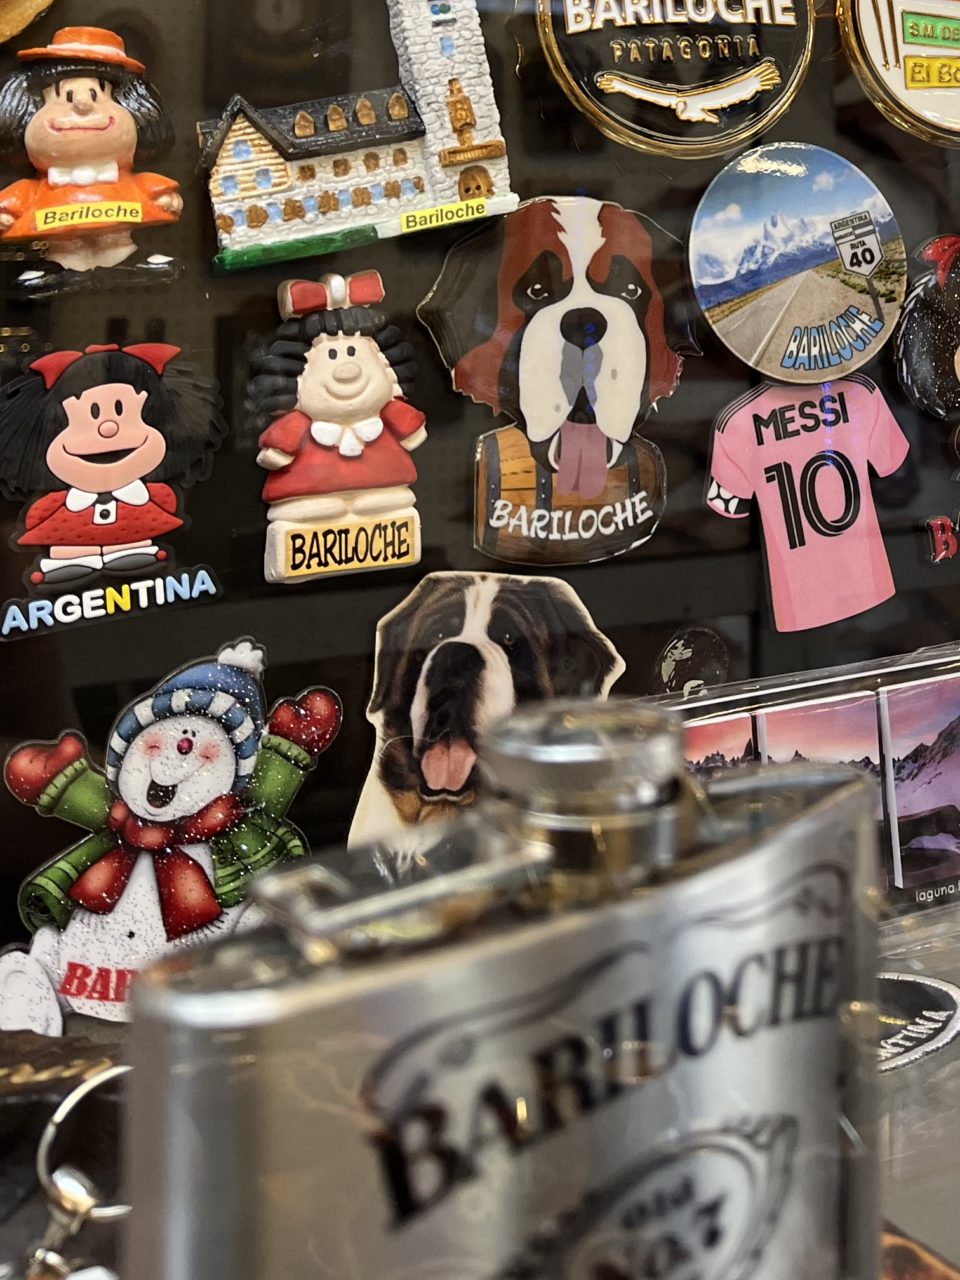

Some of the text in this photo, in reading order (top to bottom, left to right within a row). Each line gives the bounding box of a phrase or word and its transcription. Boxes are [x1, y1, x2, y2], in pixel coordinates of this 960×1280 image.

[941, 25, 960, 42] DE
[610, 36, 761, 63] PATAGONIA
[43, 204, 141, 225] Bariloche
[405, 201, 486, 229] Bariloche
[833, 212, 868, 231] ARGENTINA
[849, 248, 875, 269] 40
[850, 239, 867, 250] RUTA
[780, 305, 885, 371] BARILOCHE
[752, 391, 850, 446] MESSI
[763, 449, 861, 550] 10
[489, 490, 654, 541] BARILOCHE
[290, 520, 410, 571] BARILOCHE
[1, 568, 218, 637] ARGENTINA
[915, 882, 955, 903] laguna
[368, 936, 848, 1236] BARILOCHE
